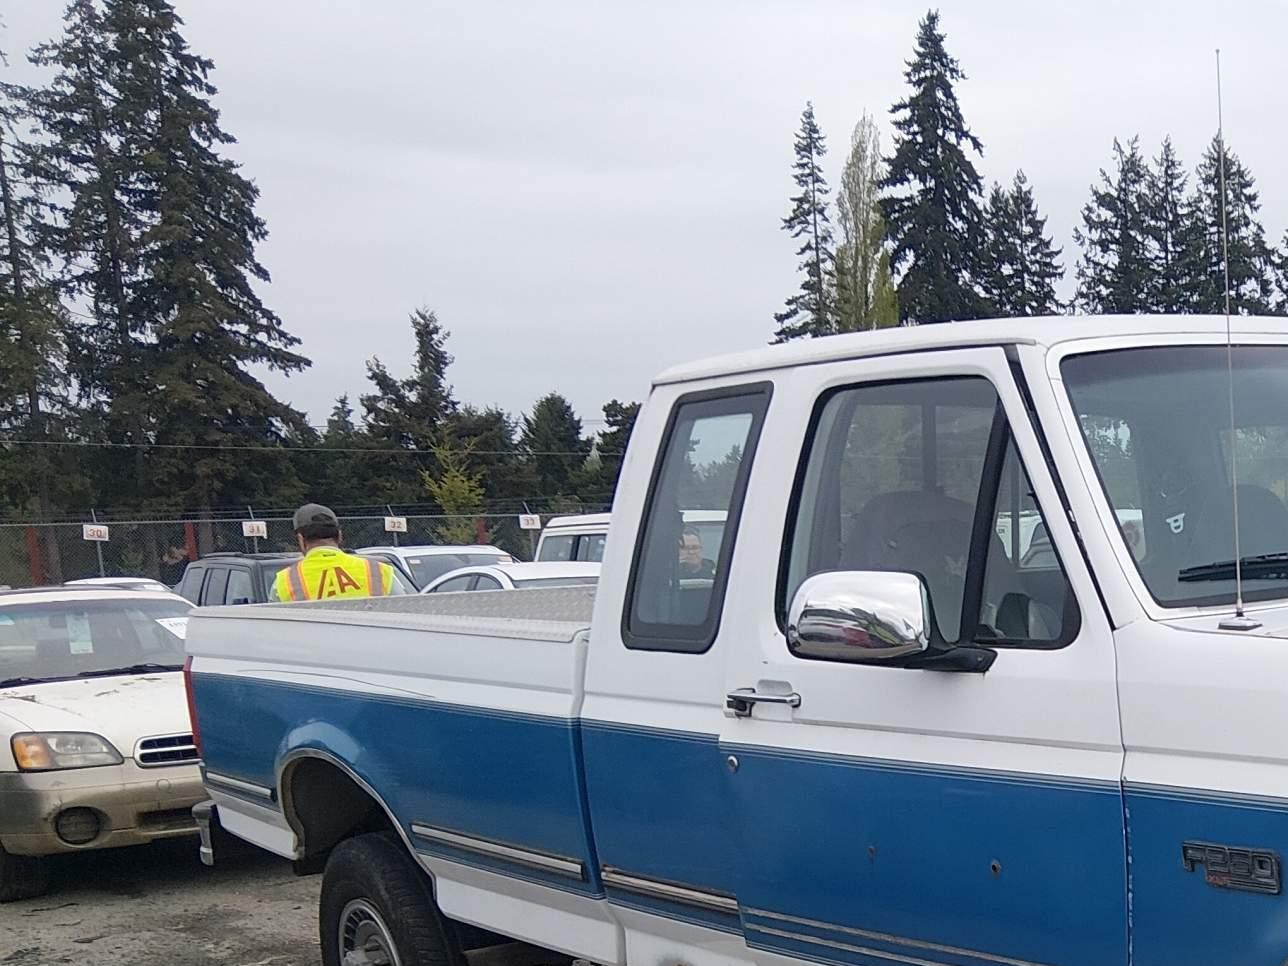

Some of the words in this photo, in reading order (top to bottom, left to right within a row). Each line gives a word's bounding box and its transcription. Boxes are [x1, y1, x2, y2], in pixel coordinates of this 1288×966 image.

[390, 520, 402, 529] 32
[88, 528, 103, 537] 30
[248, 525, 260, 534] 31
